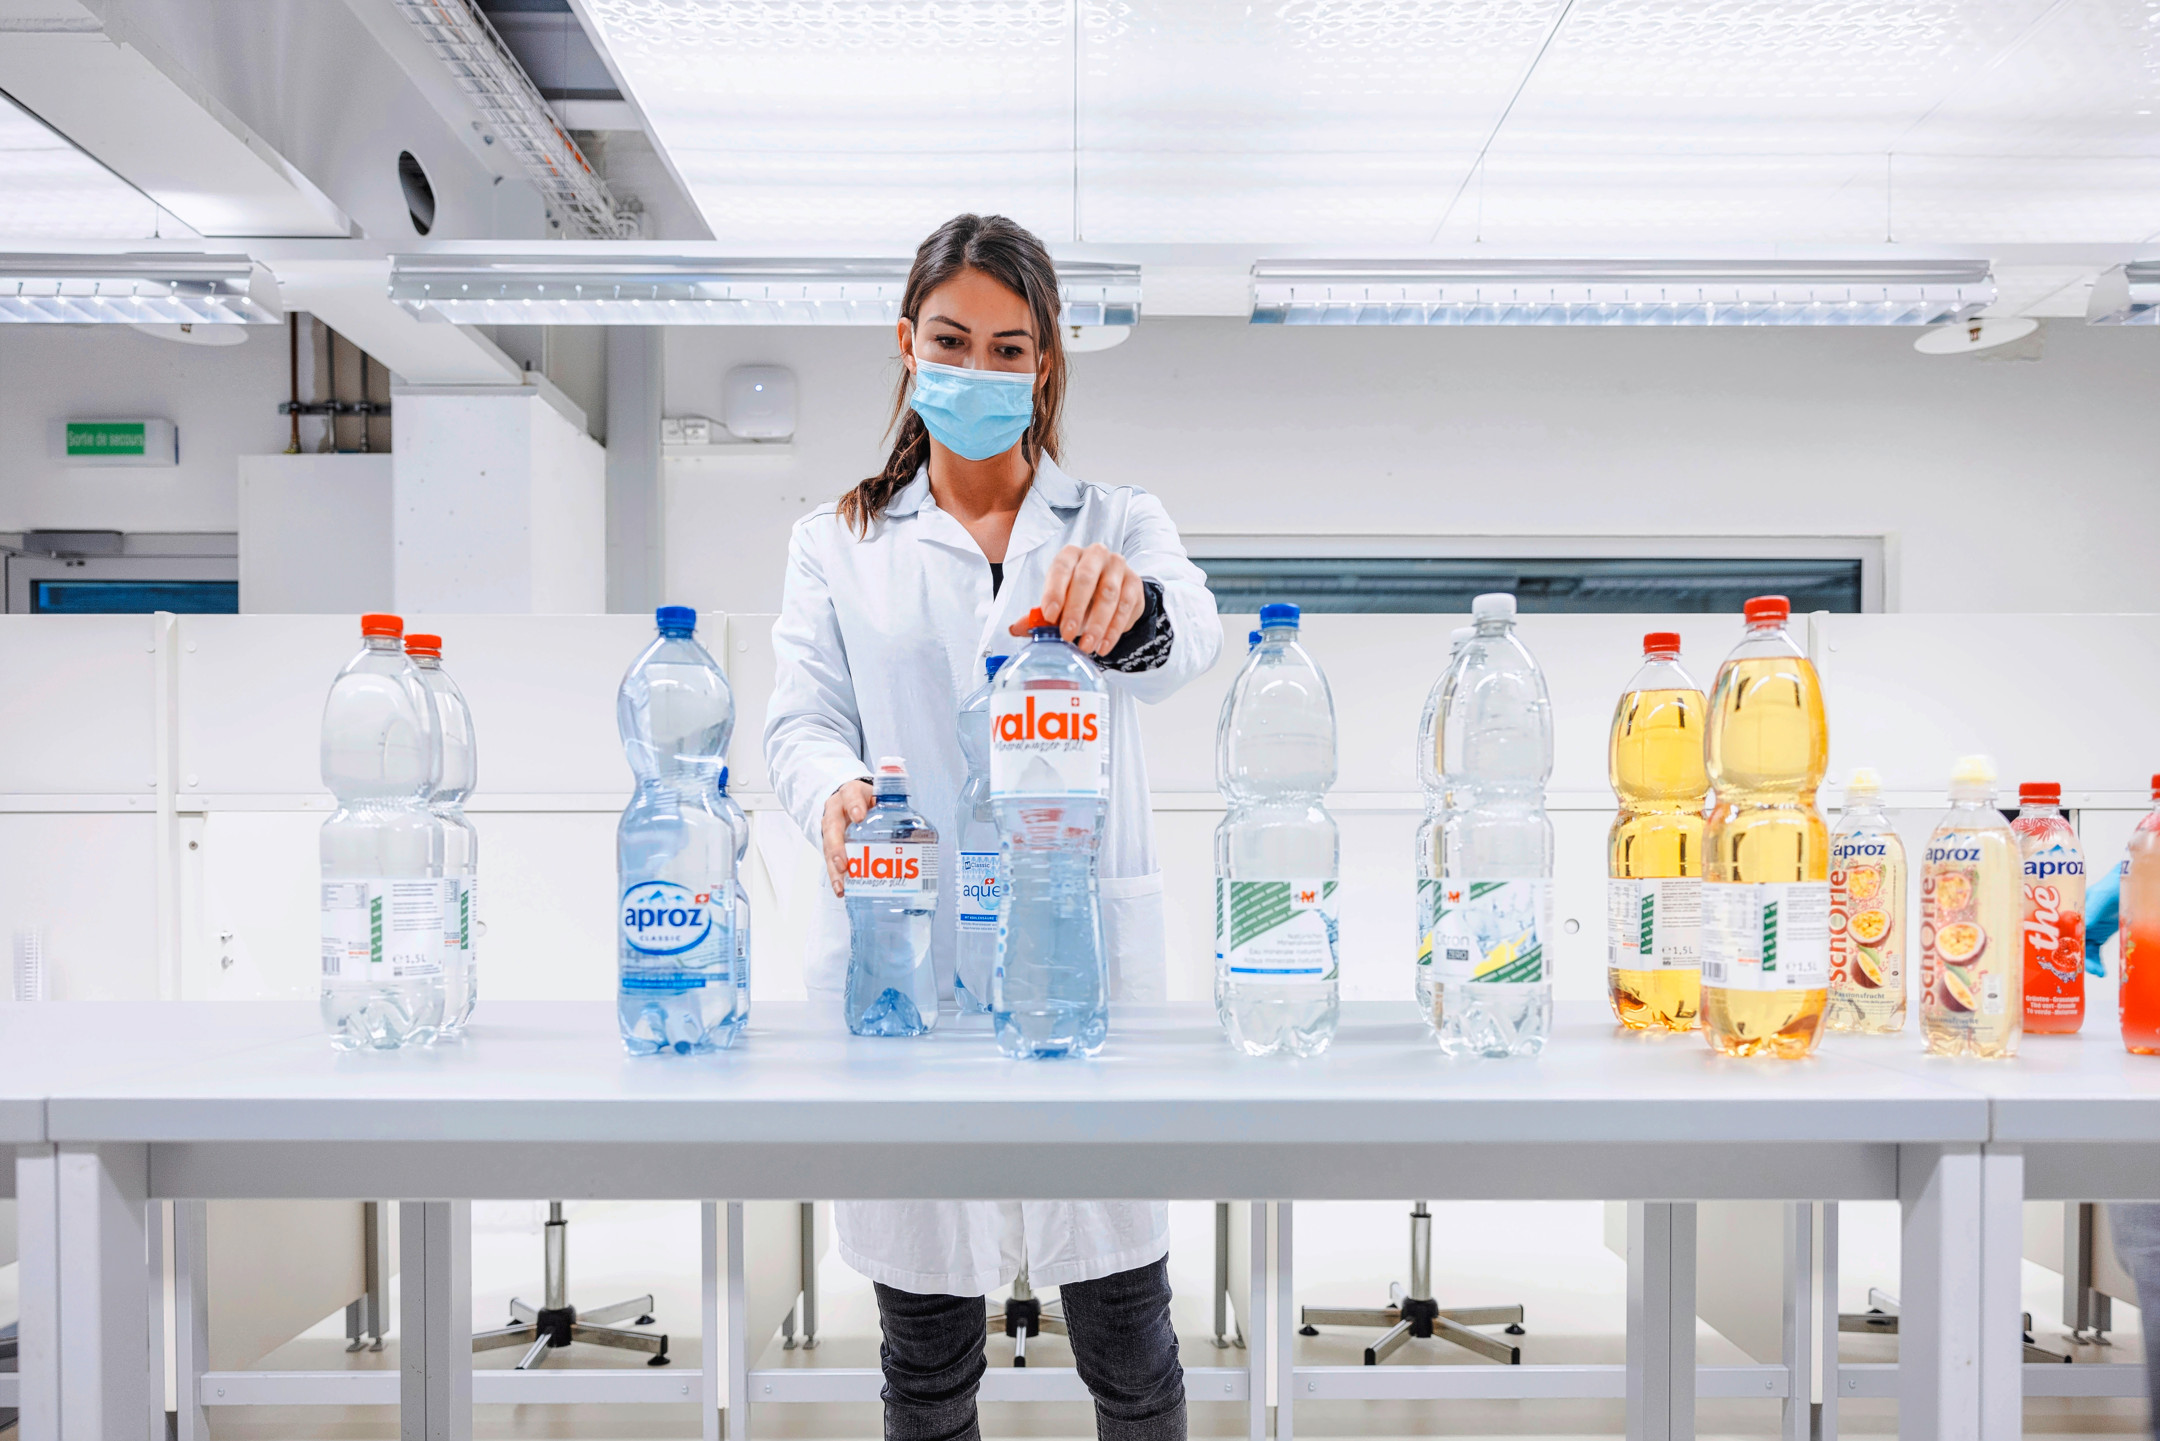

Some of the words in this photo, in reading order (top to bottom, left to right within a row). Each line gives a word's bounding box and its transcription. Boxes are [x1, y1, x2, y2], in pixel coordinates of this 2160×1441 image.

[67, 431, 94, 446] Sortie
[96, 432, 107, 446] de
[109, 434, 144, 446] secours
[991, 696, 1098, 742] valais
[1833, 844, 1886, 859] aproz
[1925, 847, 1980, 863] aproz
[847, 846, 919, 879] alais
[2024, 861, 2084, 879] aproz
[963, 885, 1000, 901] aque
[625, 908, 703, 932] aproz
